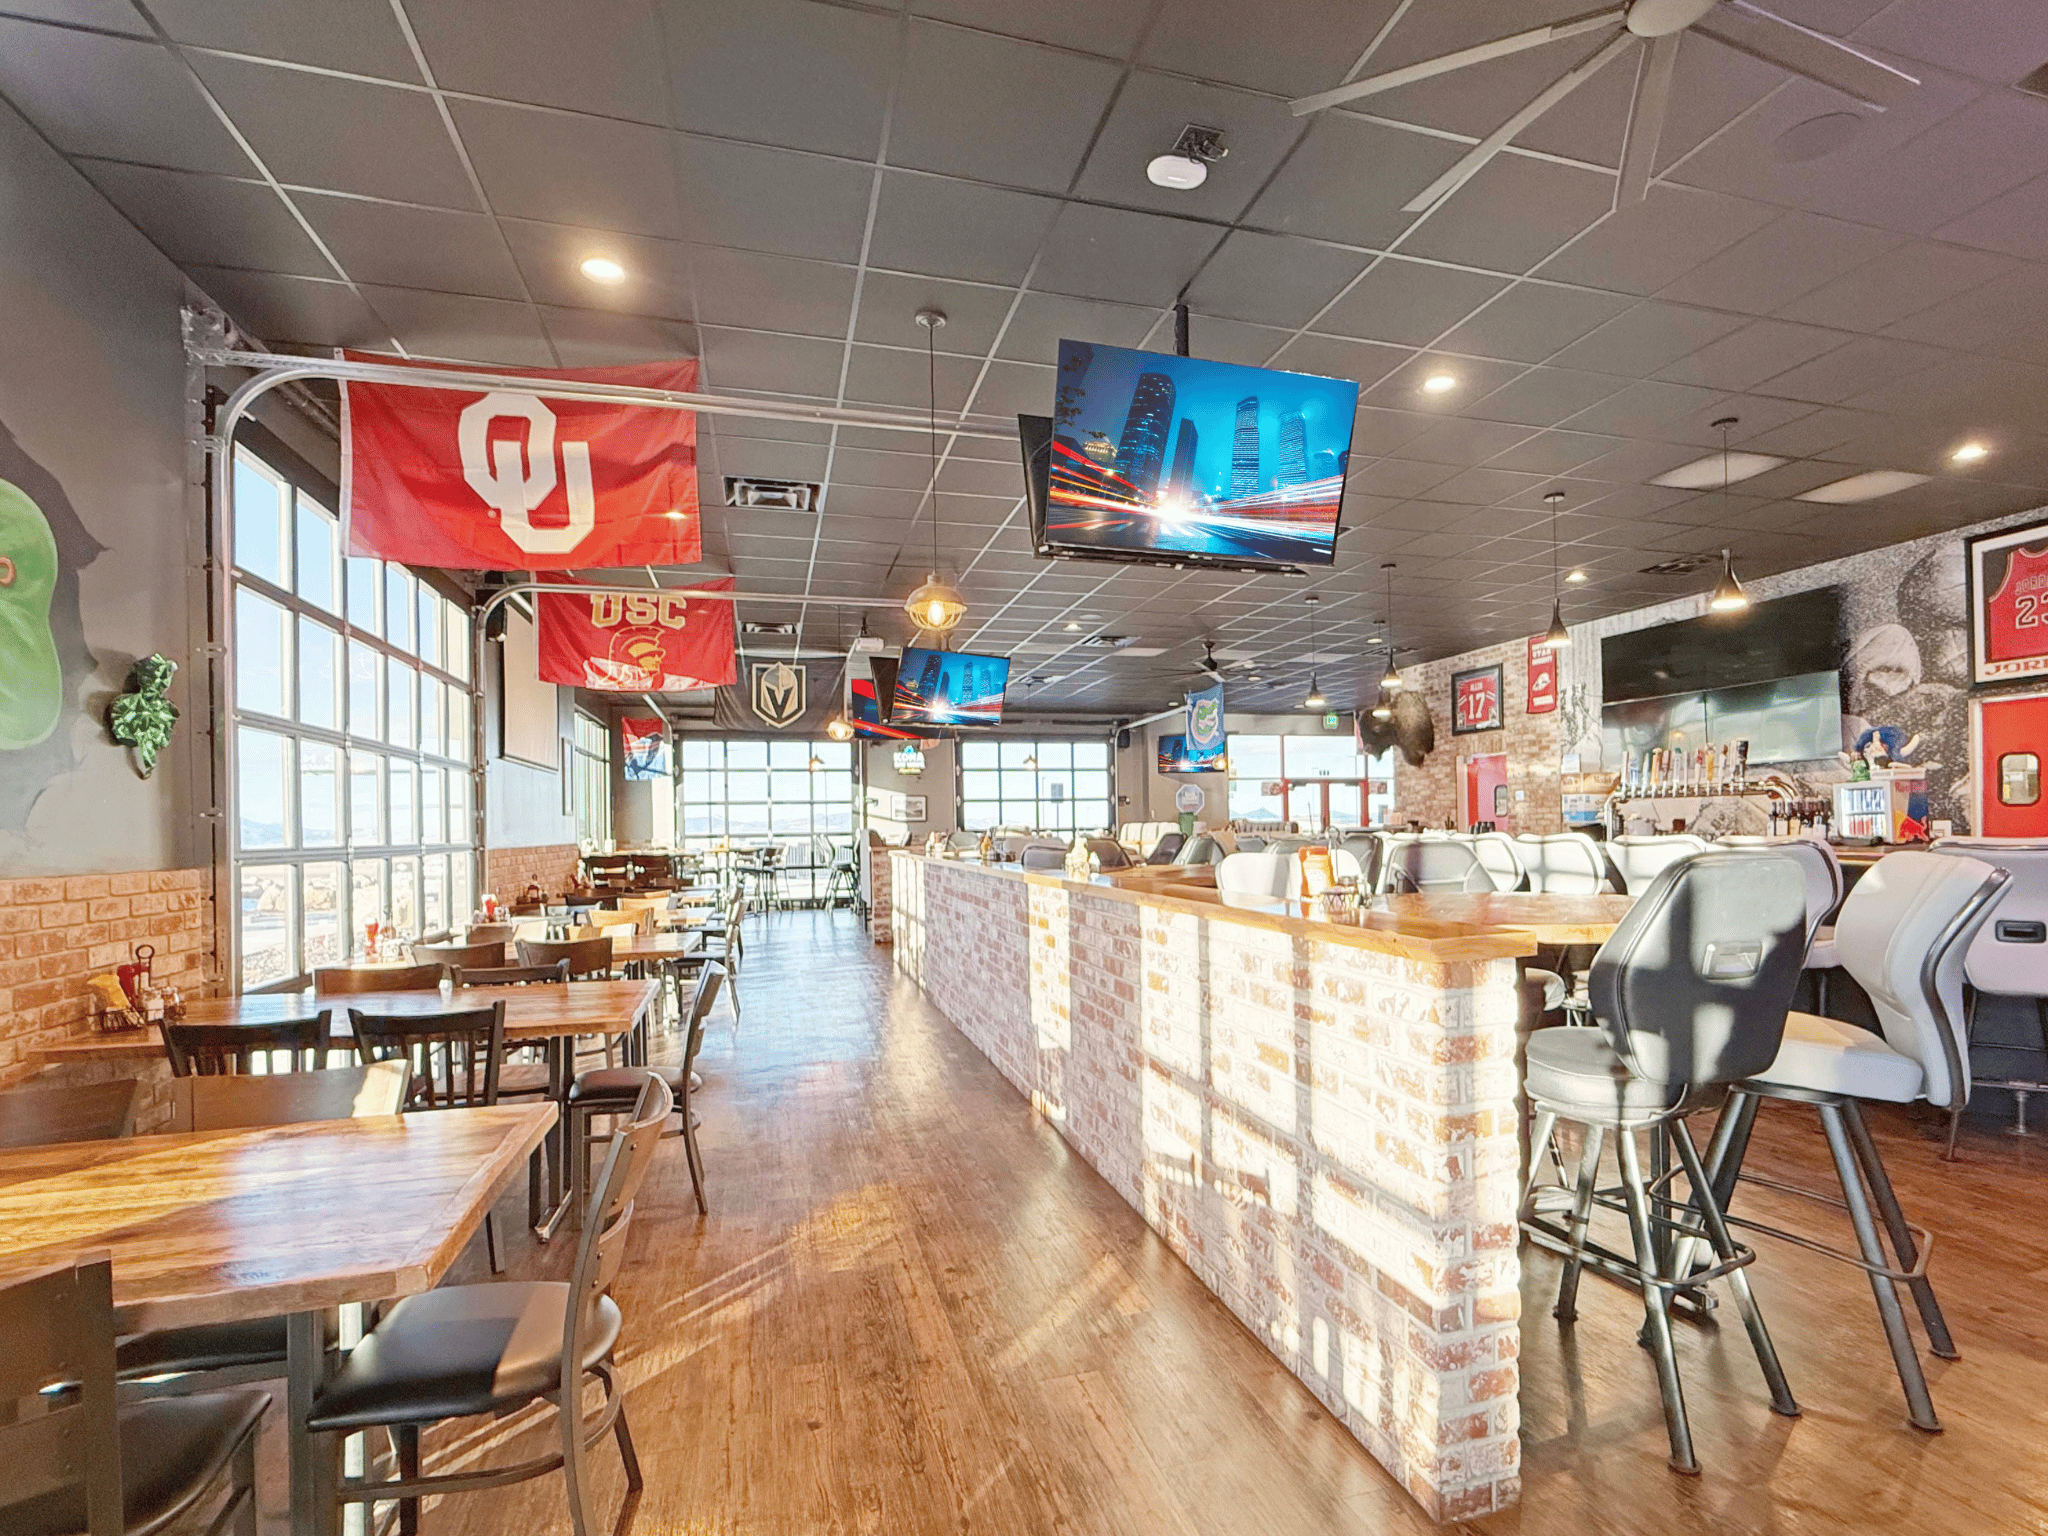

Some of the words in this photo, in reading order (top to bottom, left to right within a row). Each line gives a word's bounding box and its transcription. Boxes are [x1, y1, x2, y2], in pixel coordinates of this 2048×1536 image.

[458, 392, 595, 554] OU
[590, 593, 687, 630] USC
[1984, 659, 2048, 676] JOR
[1468, 692, 1486, 720] 17
